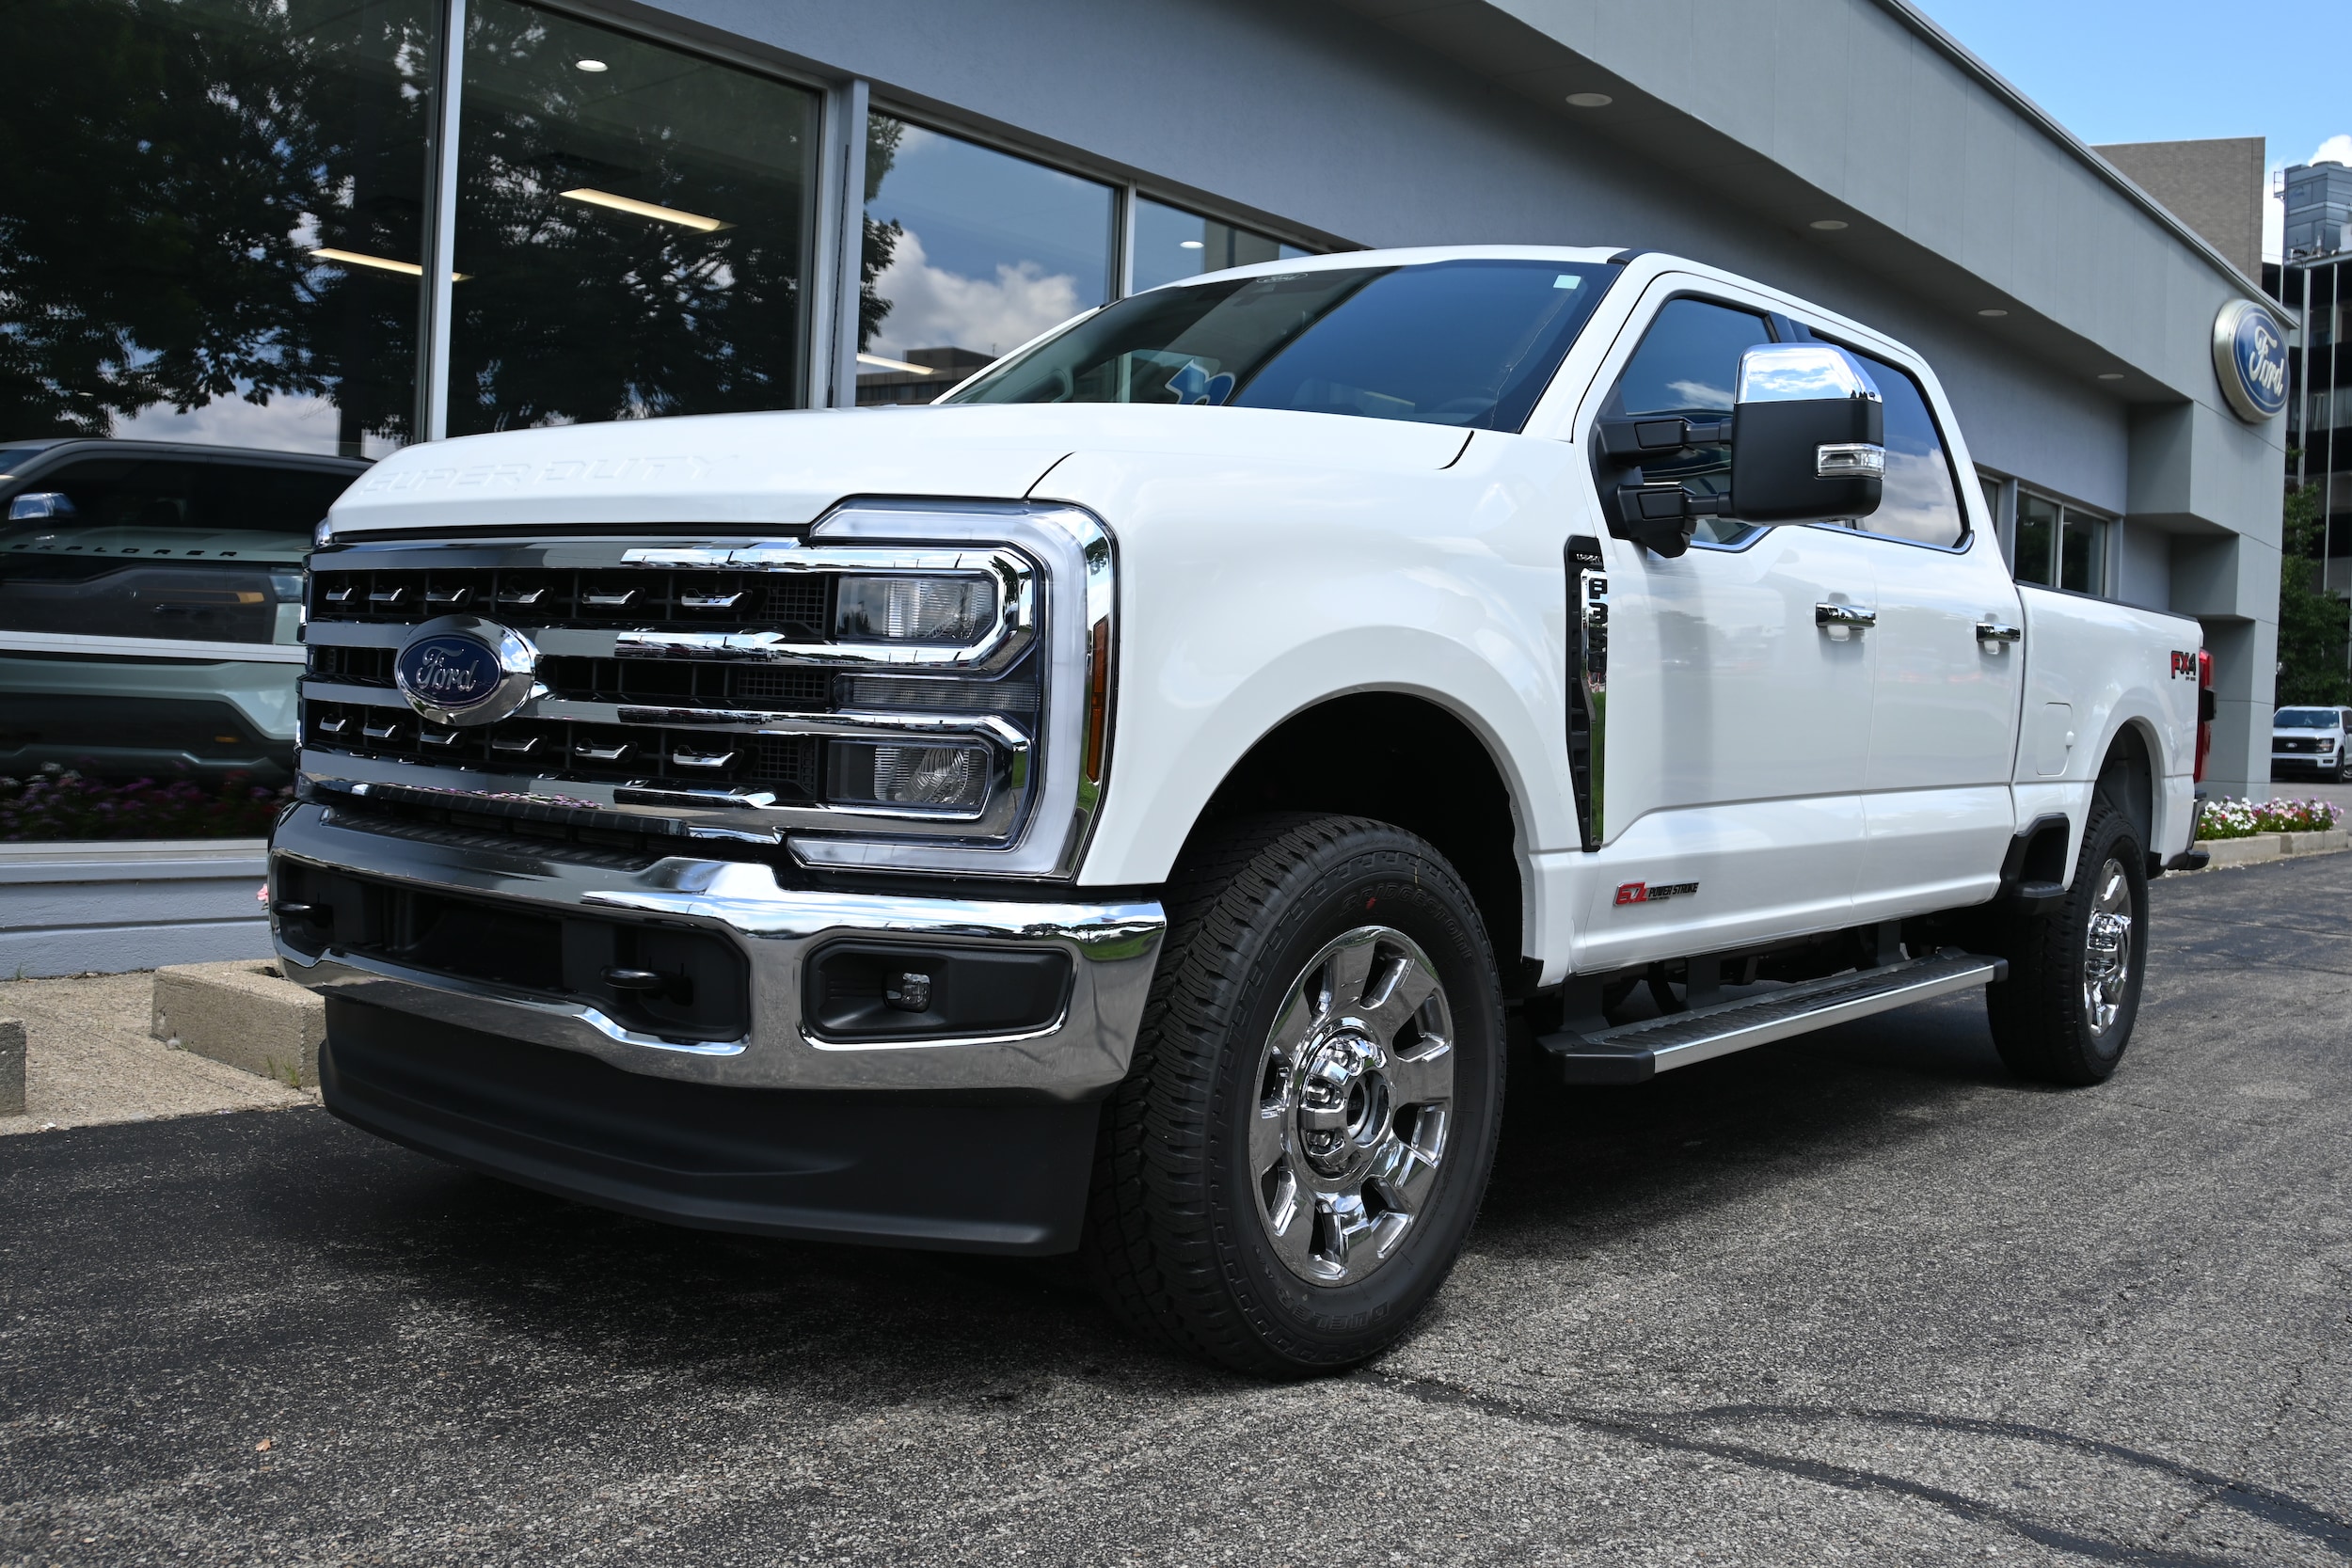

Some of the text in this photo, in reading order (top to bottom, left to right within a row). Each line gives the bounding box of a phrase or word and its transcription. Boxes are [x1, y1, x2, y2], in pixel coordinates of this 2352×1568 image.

[2249, 325, 2284, 397] Ford
[359, 454, 741, 496] SUPER DUTY
[11, 544, 237, 557] EXPLORER
[415, 645, 479, 692] Ford
[2170, 650, 2196, 679] FX4
[1648, 885, 1672, 898] POWER
[1672, 881, 1699, 895] STROKE
[1276, 1286, 1391, 1333] DUELER
